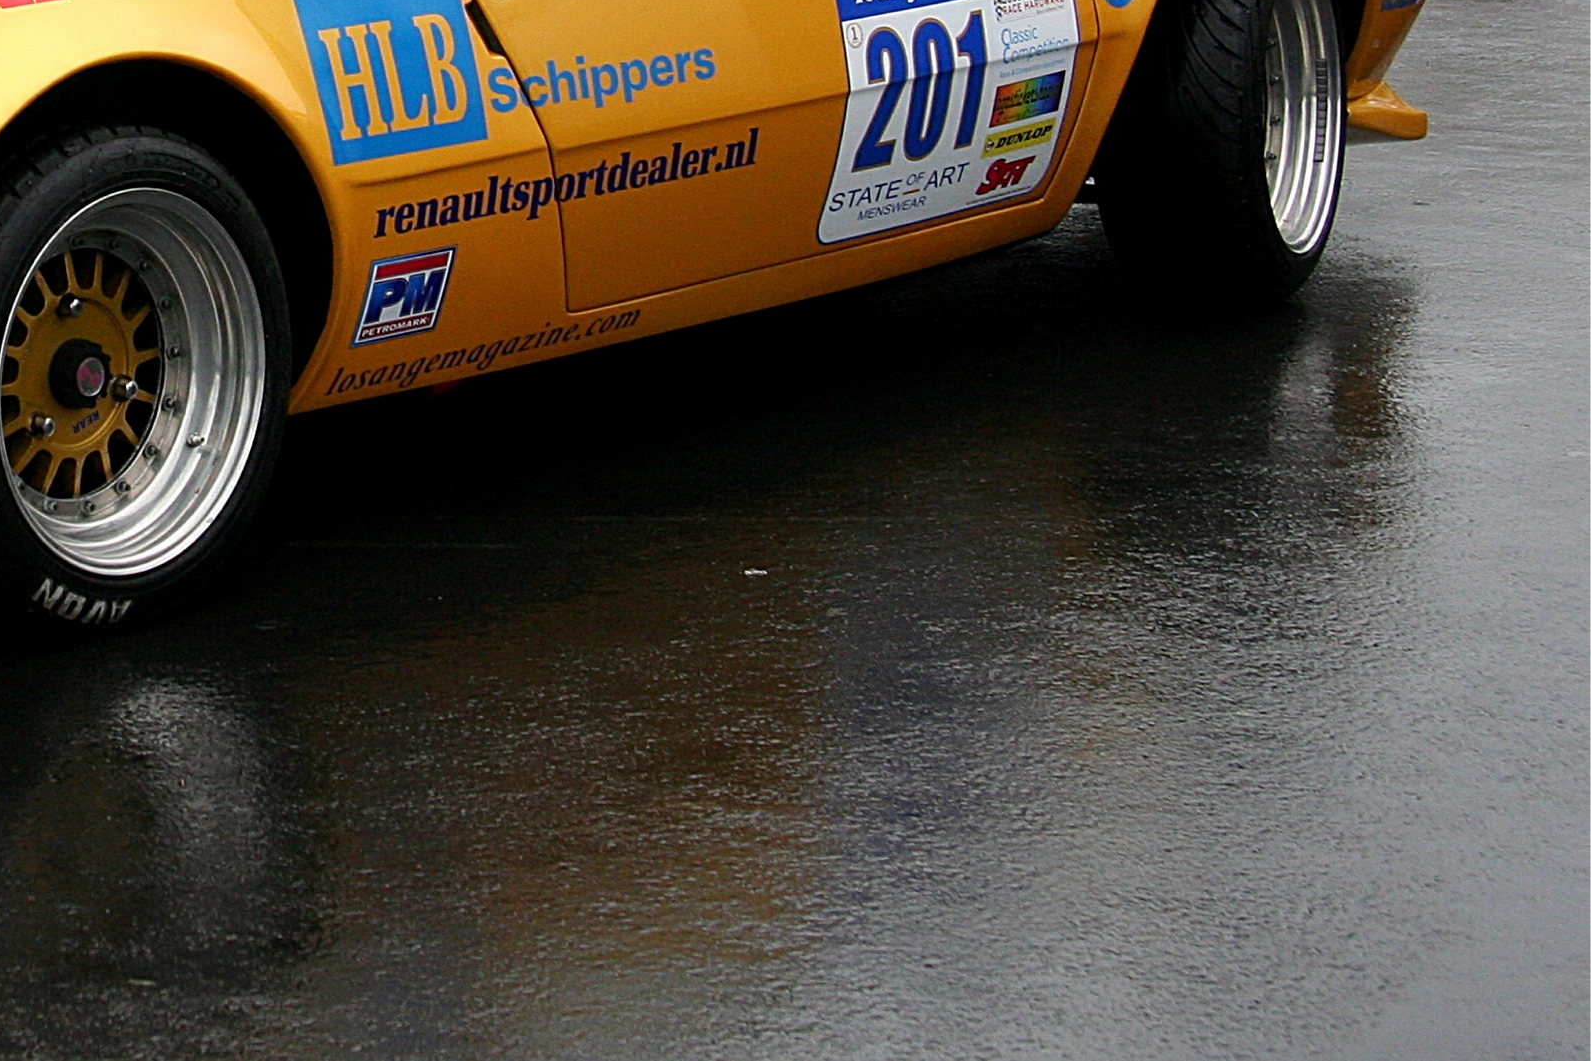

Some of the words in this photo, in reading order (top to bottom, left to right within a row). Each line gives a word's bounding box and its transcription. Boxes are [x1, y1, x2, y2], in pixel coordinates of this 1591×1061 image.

[1001, 24, 1038, 46] Classic
[1003, 37, 1070, 65] Competition
[317, 13, 468, 141] HLB
[487, 47, 717, 113] Schippers
[851, 9, 988, 173] 201
[995, 124, 1053, 149] DUNLOP
[373, 127, 760, 239] renaultsportdealer.nl
[828, 178, 903, 213] STATE
[906, 171, 926, 187] OF
[923, 162, 971, 191] ART
[857, 194, 928, 221] MENSWEAR
[362, 267, 447, 325] PM
[361, 316, 428, 338] PETROMARK
[324, 306, 642, 397] losangemagazine.com
[72, 410, 100, 435] REAR
[31, 577, 133, 625] AVON
